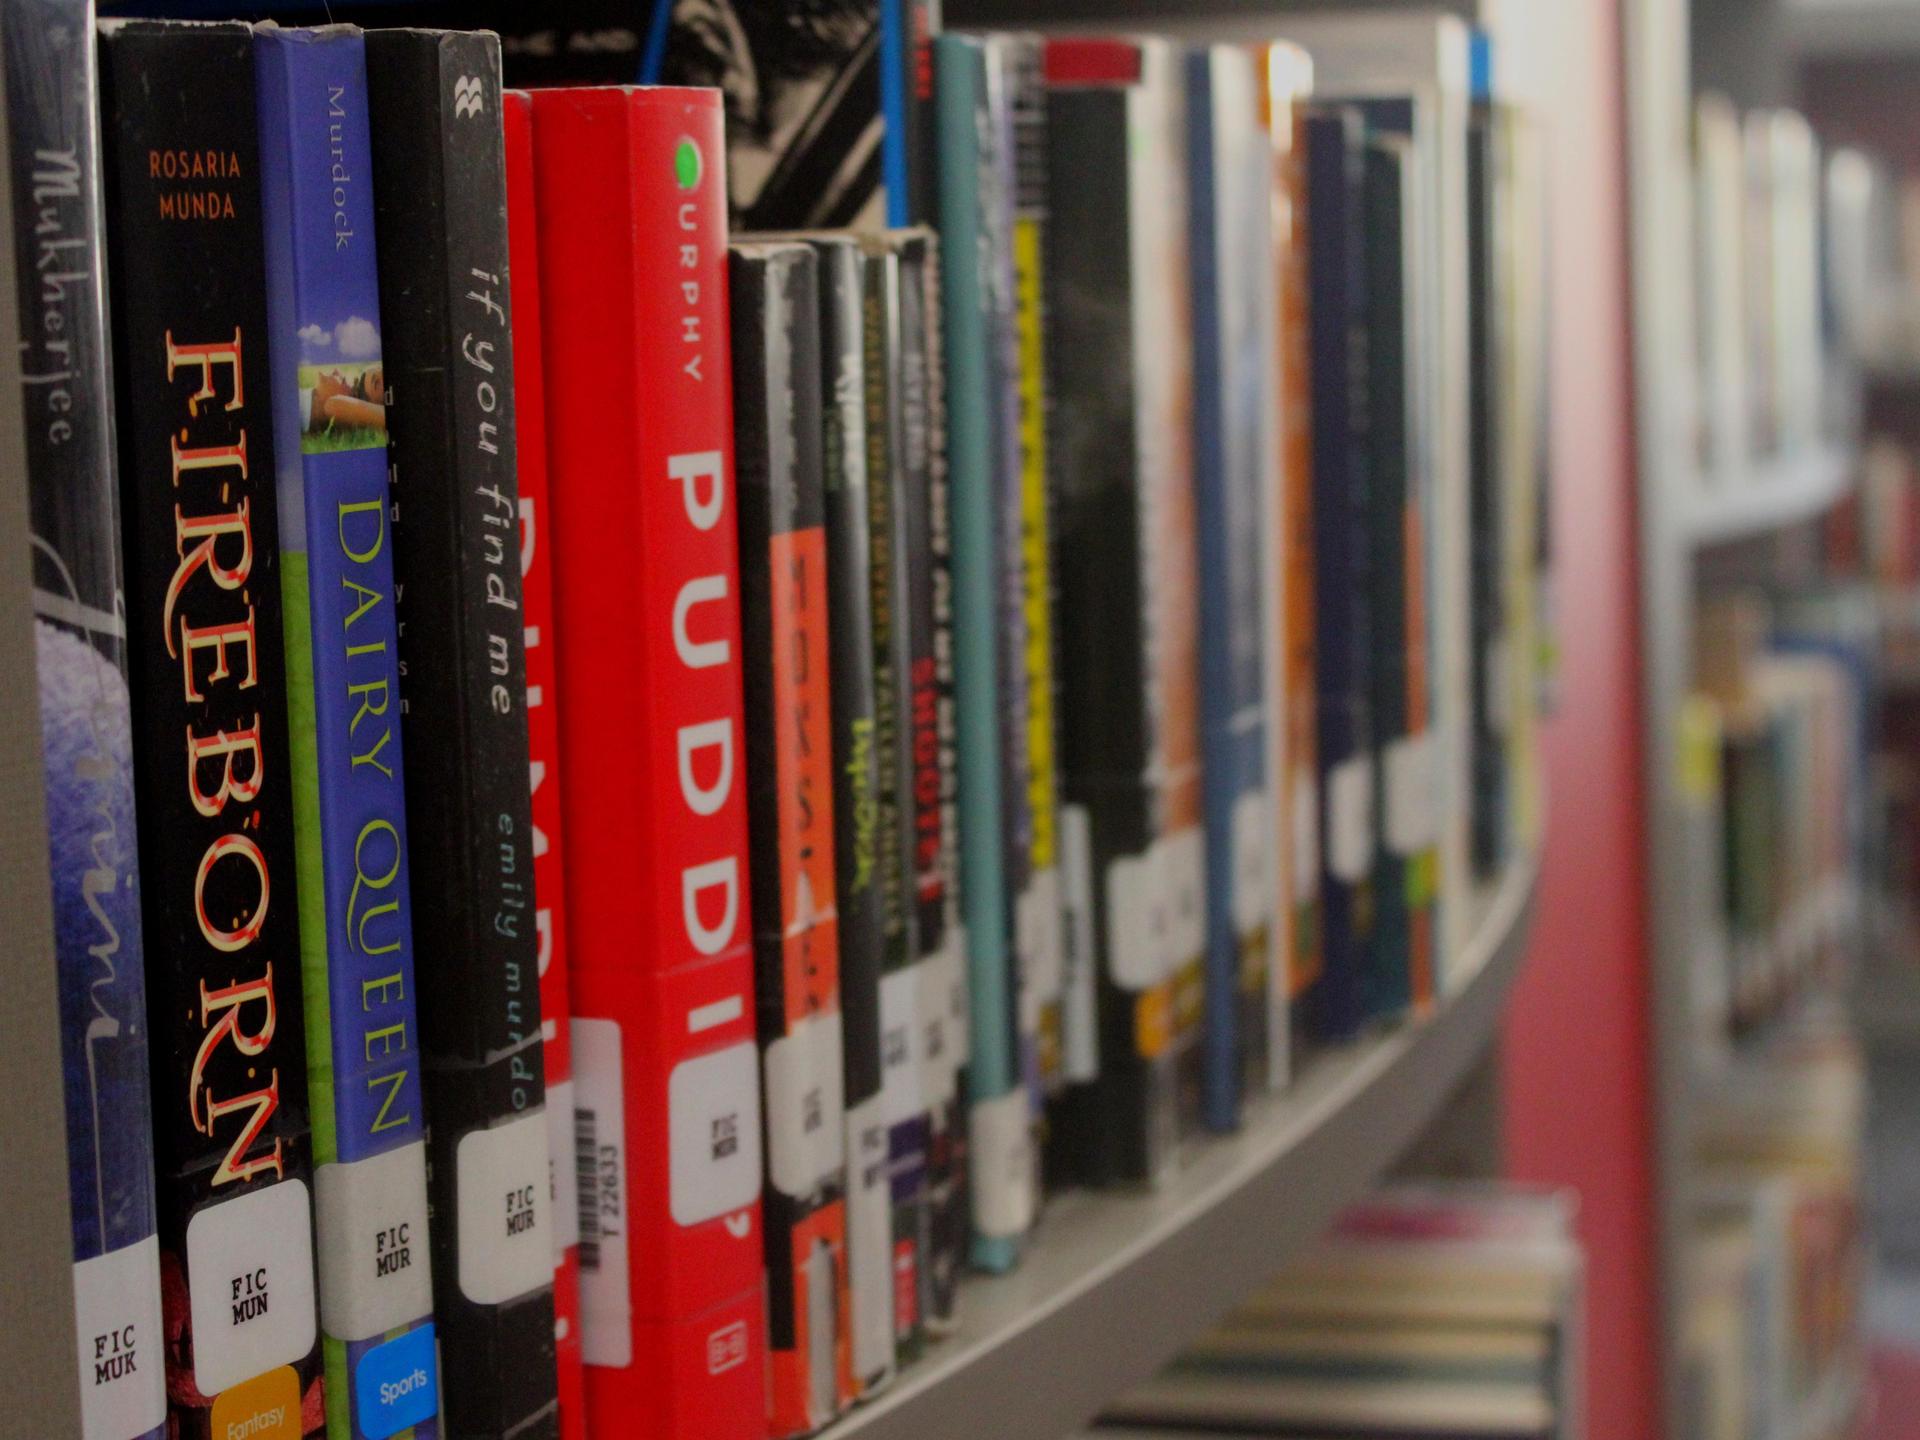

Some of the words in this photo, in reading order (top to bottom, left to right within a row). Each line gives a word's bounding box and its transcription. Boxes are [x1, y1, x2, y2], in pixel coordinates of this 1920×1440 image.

[149, 149, 241, 179] ROSARIA
[327, 85, 355, 252] Murdock
[159, 192, 236, 221] MUNDA
[21, 143, 90, 446] Mukherjee
[464, 266, 506, 326] if
[677, 202, 703, 382] URPHY
[461, 333, 498, 455] you
[474, 483, 518, 610] find
[337, 495, 394, 781] DAIRY
[486, 634, 512, 715] me
[164, 326, 285, 1188] FIREBORN
[667, 450, 744, 1034] PUDDI
[494, 812, 527, 939] emily
[346, 818, 411, 1134] QUEEN
[505, 961, 535, 1111] murdo
[506, 1185, 535, 1213] FIC
[506, 1208, 536, 1238] MUR
[376, 1222, 411, 1253] FIC
[376, 1247, 412, 1279] MUR
[231, 1268, 268, 1301] FIC
[232, 1293, 269, 1326] MUN
[94, 1325, 137, 1359] FIC
[94, 1351, 138, 1386] MUK
[378, 1366, 429, 1407] Sports
[227, 1404, 287, 1440] Fantasy
